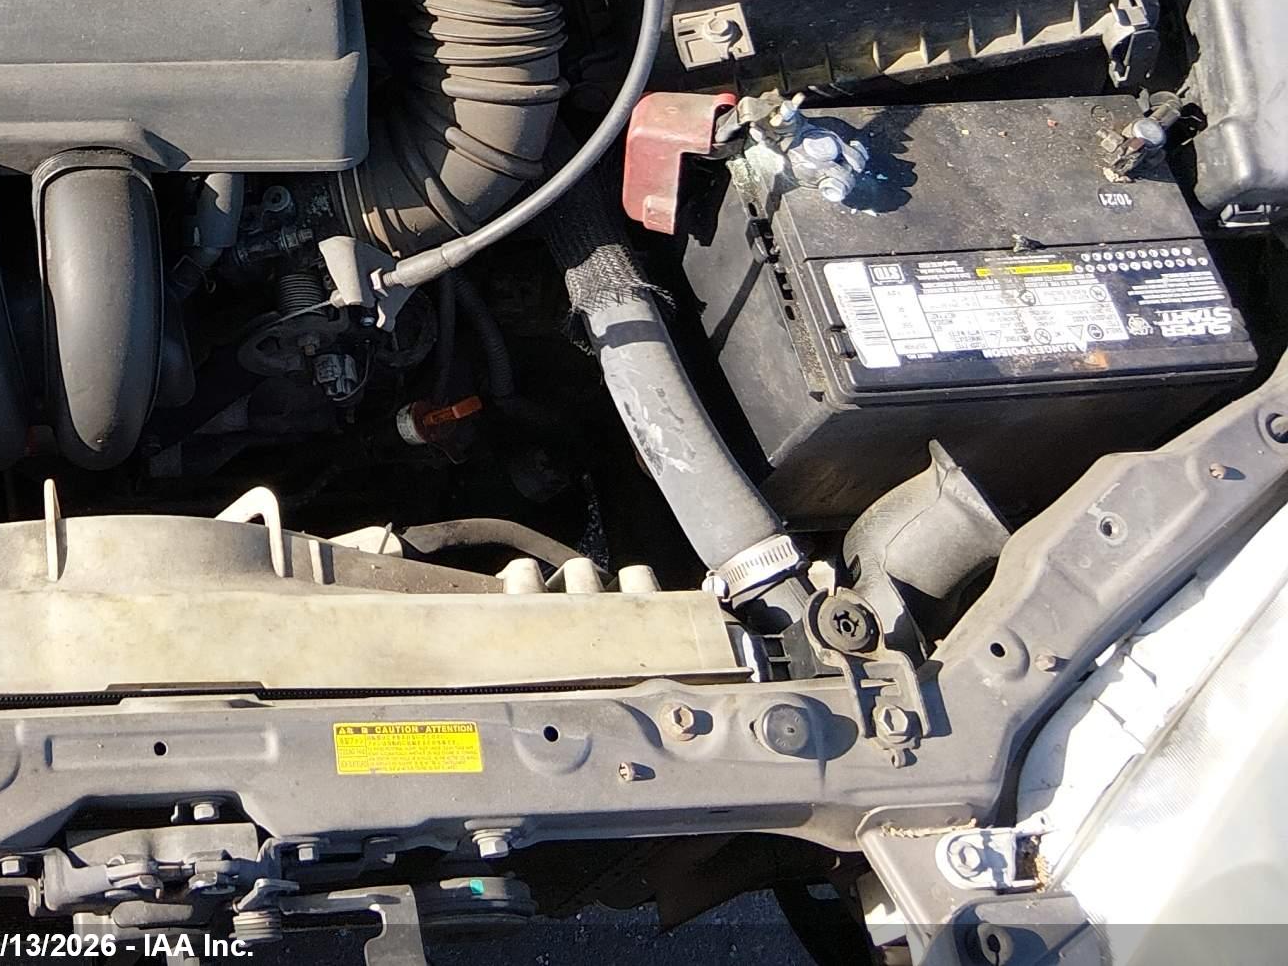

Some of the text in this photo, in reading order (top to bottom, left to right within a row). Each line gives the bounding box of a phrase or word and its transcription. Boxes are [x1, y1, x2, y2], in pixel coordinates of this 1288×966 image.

[1161, 323, 1232, 338] SUPER
[374, 725, 419, 734] CAUTION
[425, 724, 474, 733] ATTENTION
